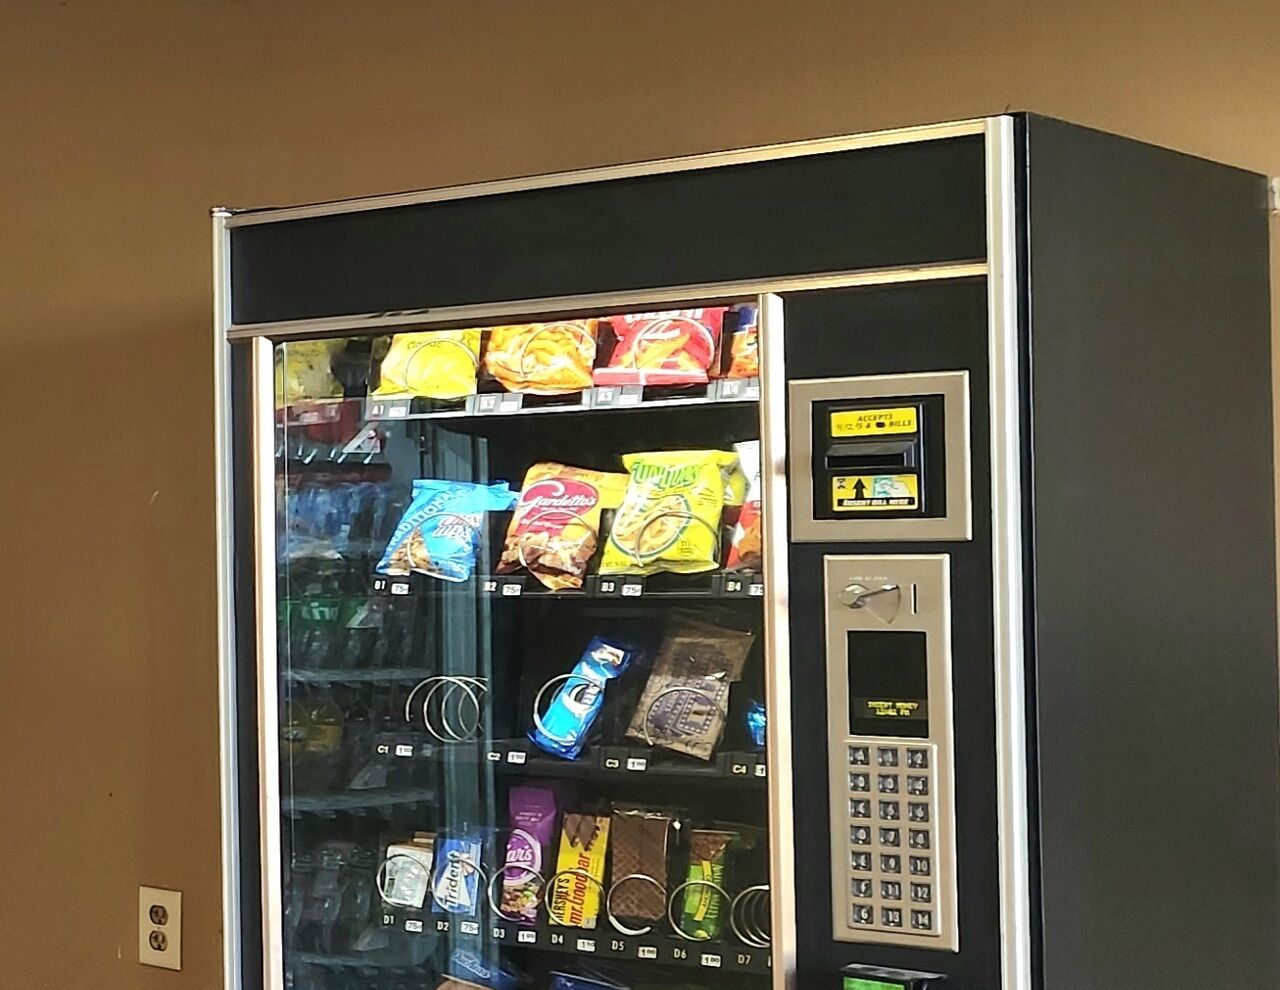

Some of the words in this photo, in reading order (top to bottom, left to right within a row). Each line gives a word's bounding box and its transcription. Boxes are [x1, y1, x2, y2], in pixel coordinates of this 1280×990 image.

[371, 405, 385, 416] A1
[857, 413, 893, 422] ACCEPTS
[520, 480, 597, 519] Gardetto's
[374, 580, 386, 590] B1
[483, 581, 497, 592] B2
[601, 582, 615, 592] B3
[726, 581, 741, 592] B4
[377, 744, 389, 754] C1
[486, 752, 501, 761] C2
[605, 758, 619, 769] C3
[732, 764, 747, 774] C4
[445, 850, 461, 908] Trident
[383, 914, 395, 924] D1
[436, 921, 449, 931] D2
[493, 928, 505, 938] D3
[551, 933, 564, 944] D4
[611, 940, 625, 951] D5
[673, 949, 687, 959] D6
[737, 954, 751, 965] D7
